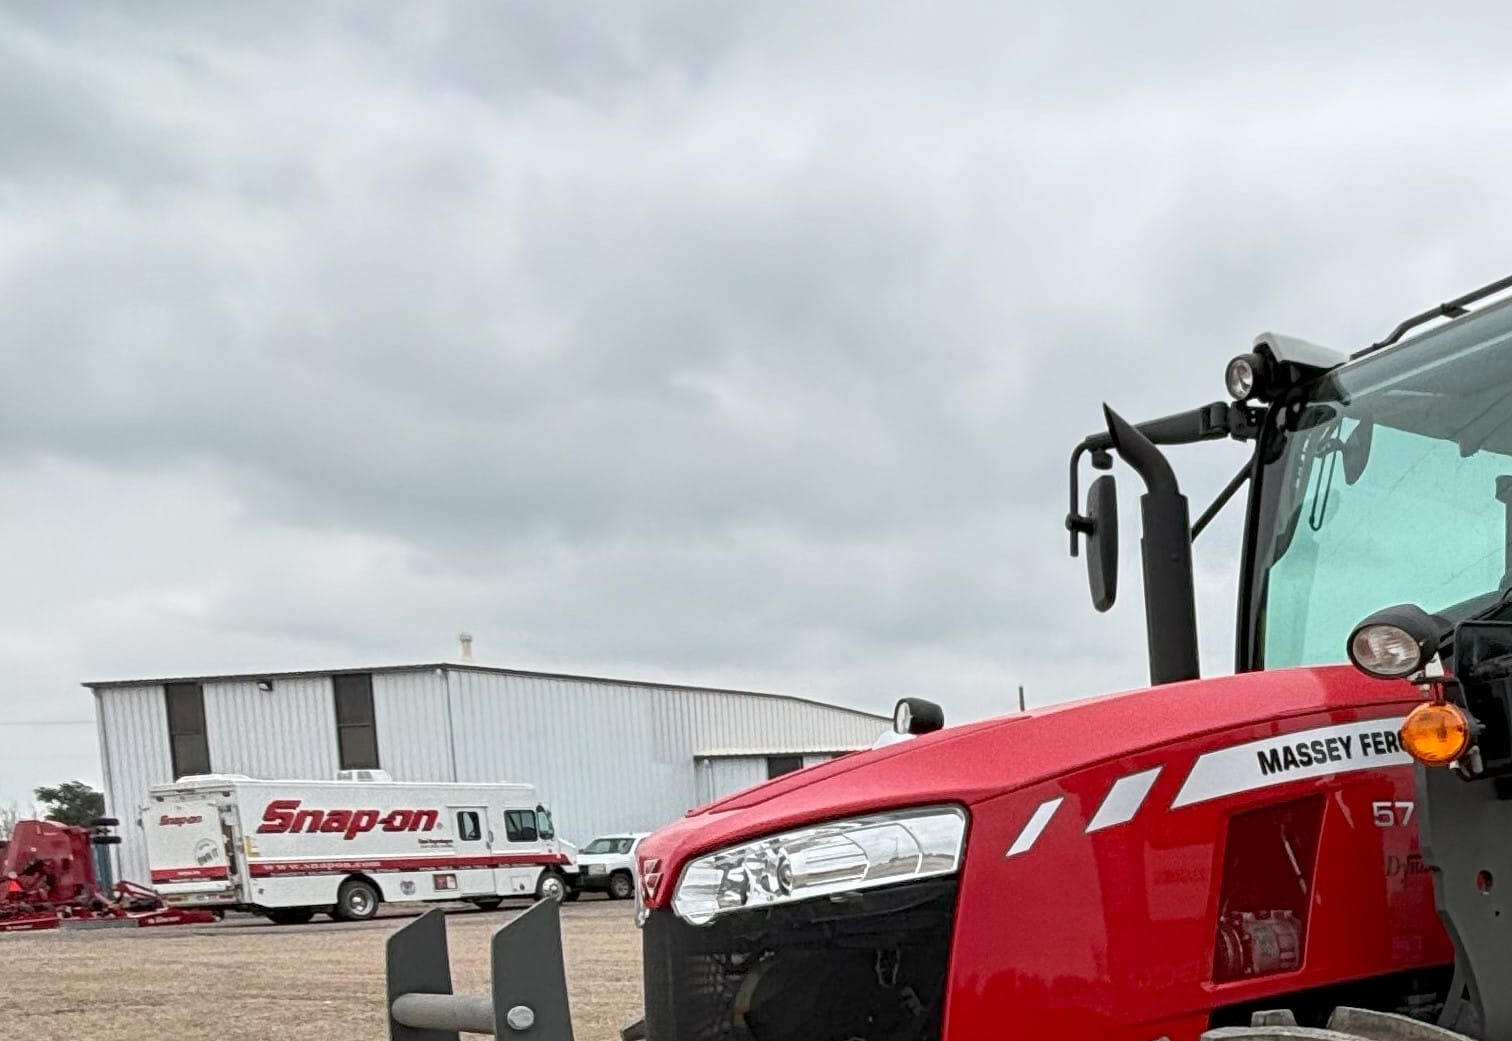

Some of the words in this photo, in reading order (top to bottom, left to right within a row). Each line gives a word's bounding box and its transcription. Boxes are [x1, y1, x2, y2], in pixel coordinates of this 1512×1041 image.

[1256, 735, 1352, 776] MASSEY
[160, 815, 202, 827] Snap-on
[256, 799, 439, 841] Snap-on
